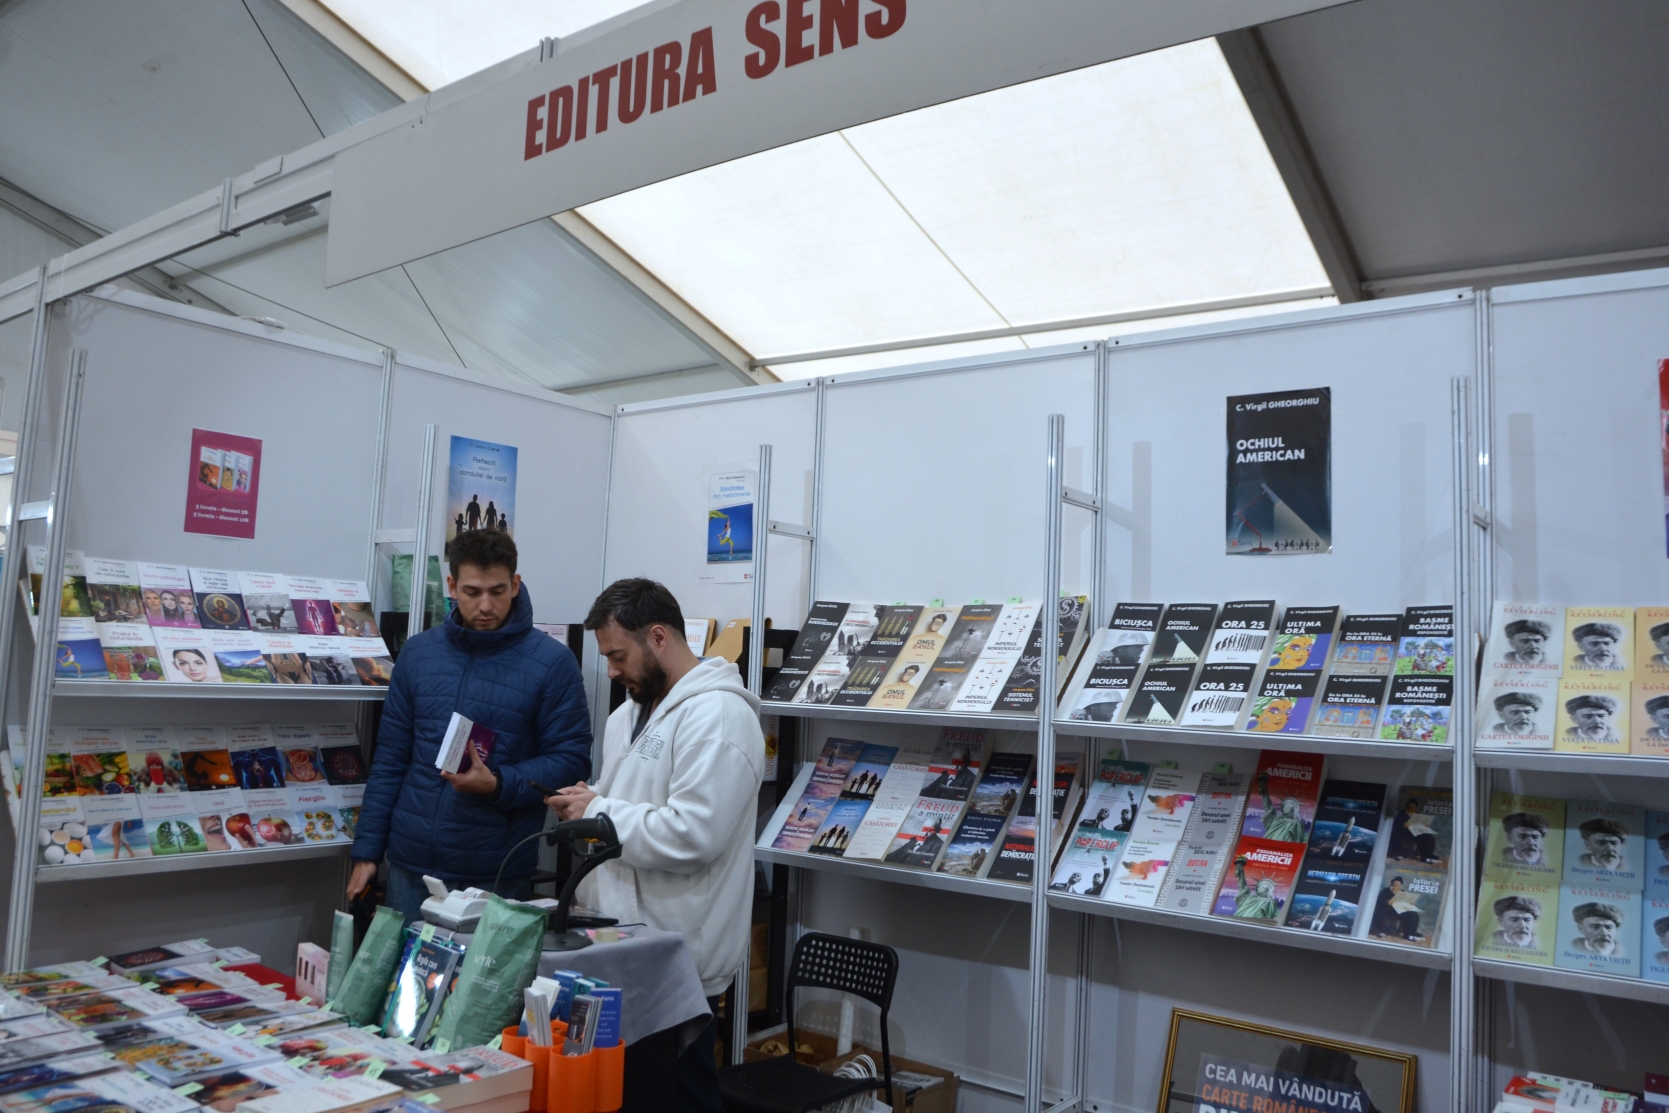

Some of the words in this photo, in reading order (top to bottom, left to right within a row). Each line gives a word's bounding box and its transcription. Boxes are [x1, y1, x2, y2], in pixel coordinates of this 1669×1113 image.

[524, 26, 717, 161] EDITURA
[1246, 402, 1267, 412] Virgil
[1268, 397, 1320, 408] GHEORGHIU
[1236, 437, 1285, 450] OCHIUL
[1236, 449, 1305, 464] AMERICAN
[1114, 619, 1153, 628] BICIUȘCA
[1250, 621, 1265, 629] 25
[1409, 622, 1453, 631] ROMÂNEȘT
[1090, 678, 1128, 687] BICIUȘCA
[943, 729, 984, 742] FREUD
[1277, 763, 1313, 771] PSIHANALIZA
[1100, 770, 1144, 784] PAPERCLIP
[1265, 768, 1312, 781] AMERICII
[917, 799, 959, 812] FREUD
[1502, 800, 1556, 811] KEYSERLING
[1578, 806, 1635, 817] KEYSERLING
[1074, 837, 1120, 850] PAPERCLIP
[1245, 852, 1293, 865] AMERICII
[1256, 849, 1293, 858] PSIHANALIZA
[1572, 867, 1594, 876] Despre
[1413, 878, 1439, 886] Istoria
[1409, 883, 1438, 894] PRESEI
[1493, 883, 1549, 894] KEYSERLING
[1571, 889, 1631, 900] KEYSERLING
[1564, 951, 1588, 960] Despre
[1589, 953, 1607, 961] ARTA
[1205, 1063, 1237, 1084] CEA
[1242, 1071, 1274, 1092] MAI
[1278, 1078, 1362, 1112] VÂNDUTĂ
[1202, 1084, 1249, 1110] CARTE
